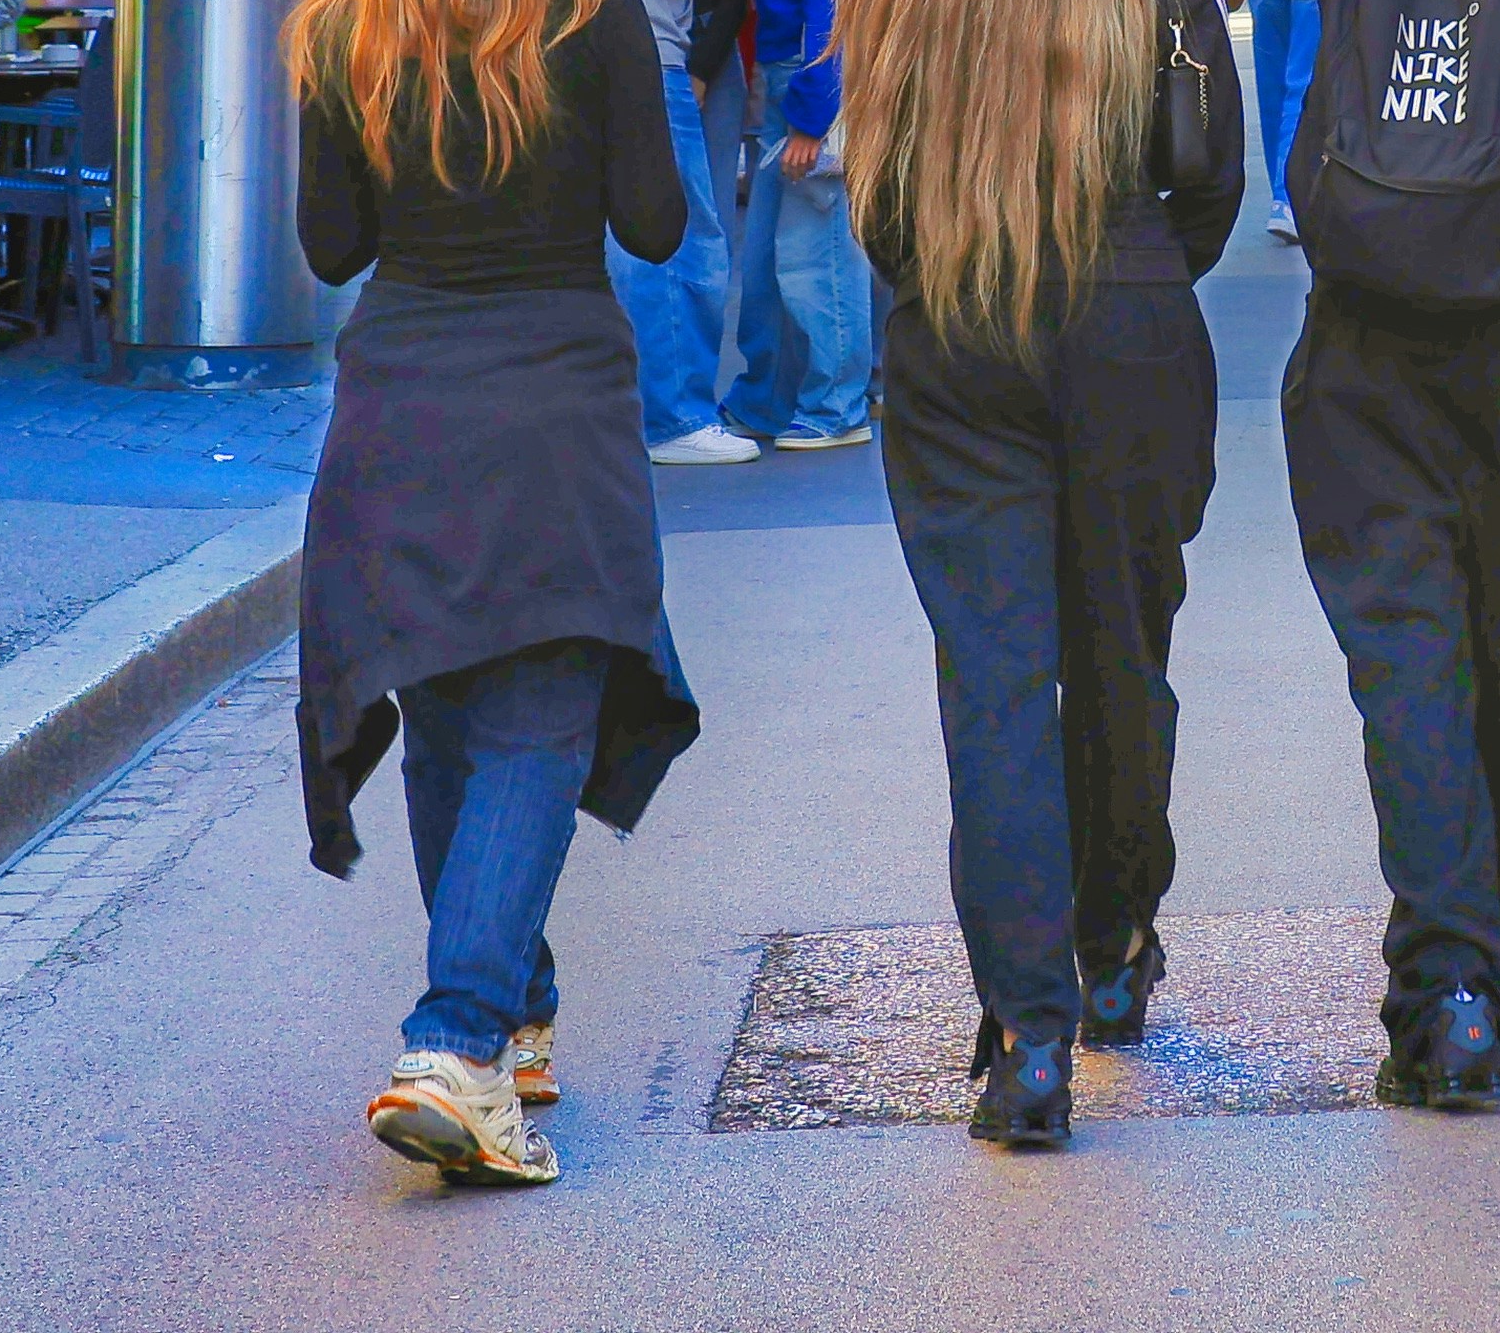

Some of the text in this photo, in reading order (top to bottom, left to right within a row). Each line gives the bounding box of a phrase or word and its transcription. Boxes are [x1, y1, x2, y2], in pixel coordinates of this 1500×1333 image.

[1396, 12, 1470, 51] NIKE
[1390, 49, 1470, 86] NIKE
[1381, 83, 1468, 126] NIKE
